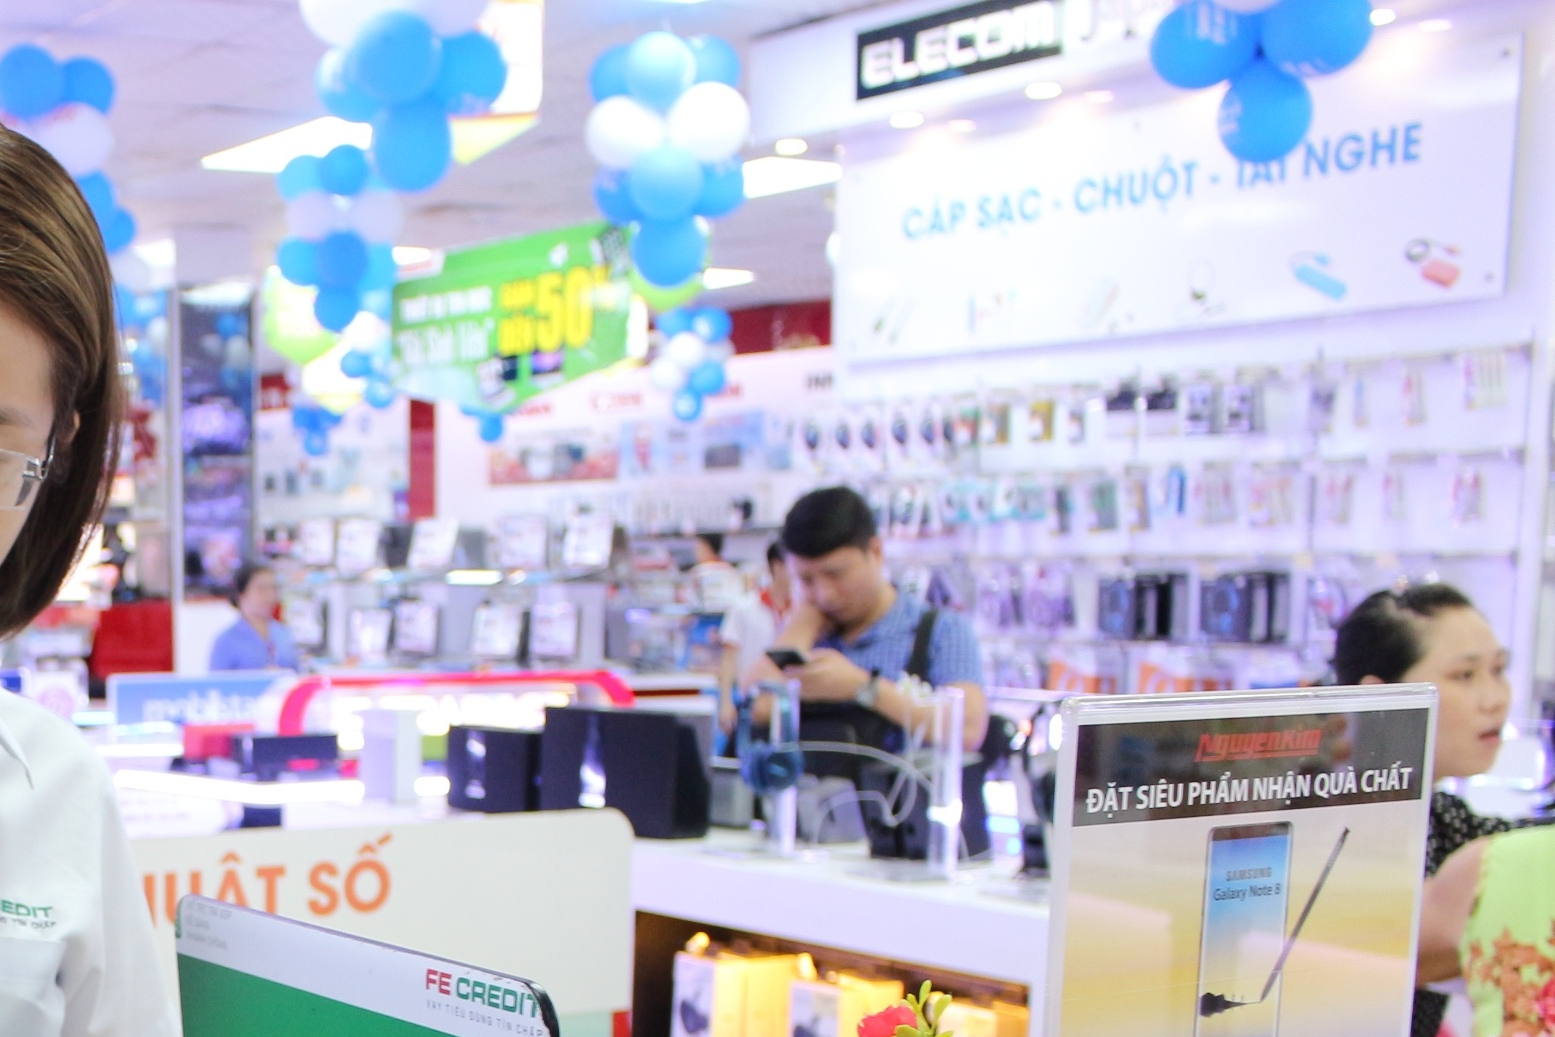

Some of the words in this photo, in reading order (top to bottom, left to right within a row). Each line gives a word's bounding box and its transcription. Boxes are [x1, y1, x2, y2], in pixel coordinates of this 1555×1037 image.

[860, 1, 1056, 89] ELECOM
[1303, 123, 1424, 176] NGHE
[1086, 781, 1134, 820] ĐẶT
[1136, 778, 1183, 812] SIÊU
[1188, 770, 1251, 807] PHẨM
[1252, 770, 1312, 806] NHẬN
[1314, 769, 1358, 800] QUÀ
[1361, 760, 1414, 794] CHẤT
[307, 833, 394, 917] SỐ
[1213, 886, 1248, 902] Galaxy
[1249, 884, 1274, 897] Note
[1274, 882, 1282, 895] 8
[1226, 867, 1273, 882] SAMSUNG
[425, 968, 453, 996] FE
[455, 976, 540, 1019] CREDIT
